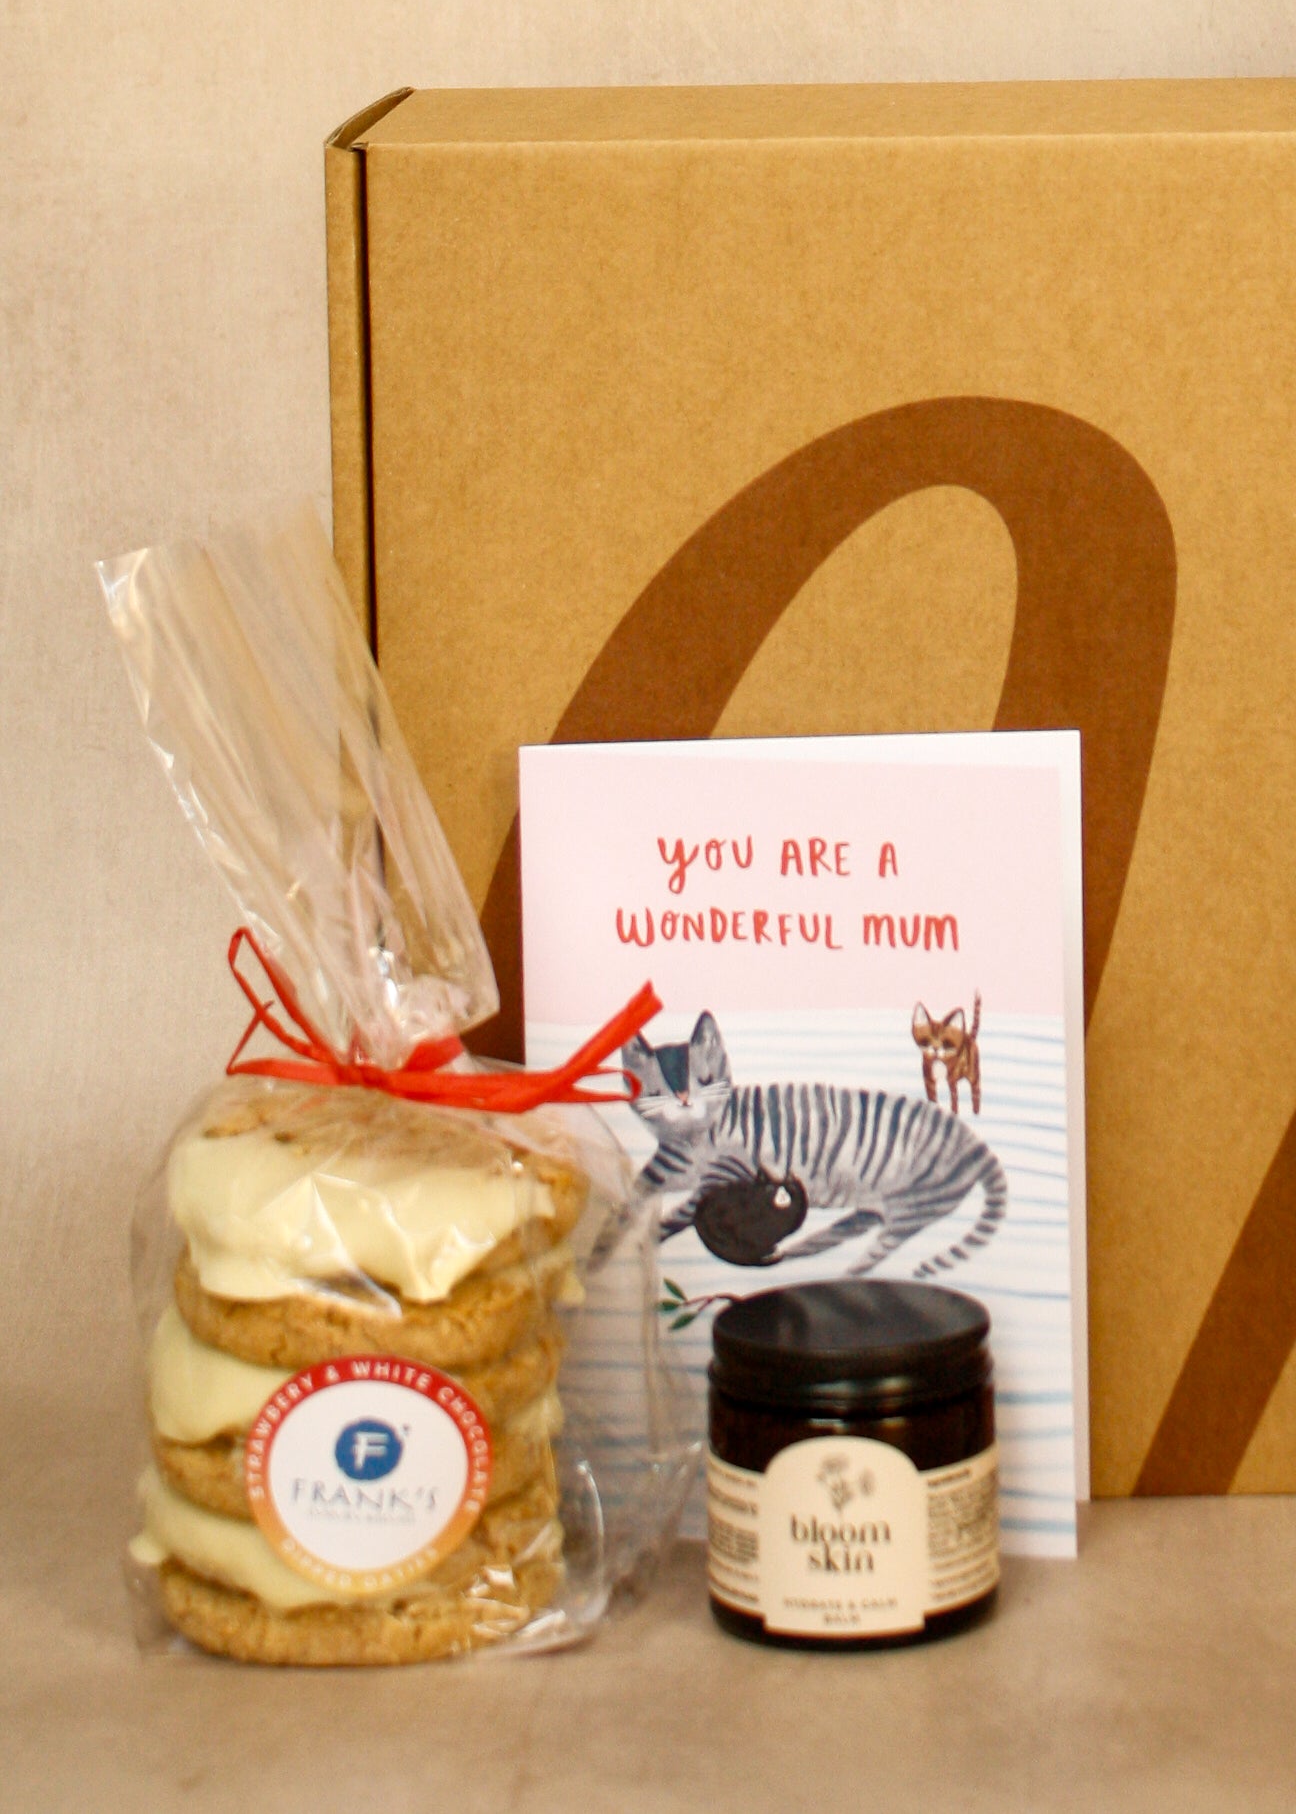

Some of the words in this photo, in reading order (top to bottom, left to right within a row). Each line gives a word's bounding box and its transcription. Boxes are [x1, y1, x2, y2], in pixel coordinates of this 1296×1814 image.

[657, 835, 753, 894] YOU
[780, 837, 851, 877] ARE
[878, 842, 898, 878] A
[616, 906, 843, 949] WONDERFUL
[863, 913, 959, 951] MUM
[350, 1360, 433, 1392] WHITE
[436, 1386, 489, 1515] CHOCOLATE
[291, 1478, 440, 1511] FRANK'S
[790, 1514, 892, 1544] bloom
[808, 1541, 875, 1572] skin
